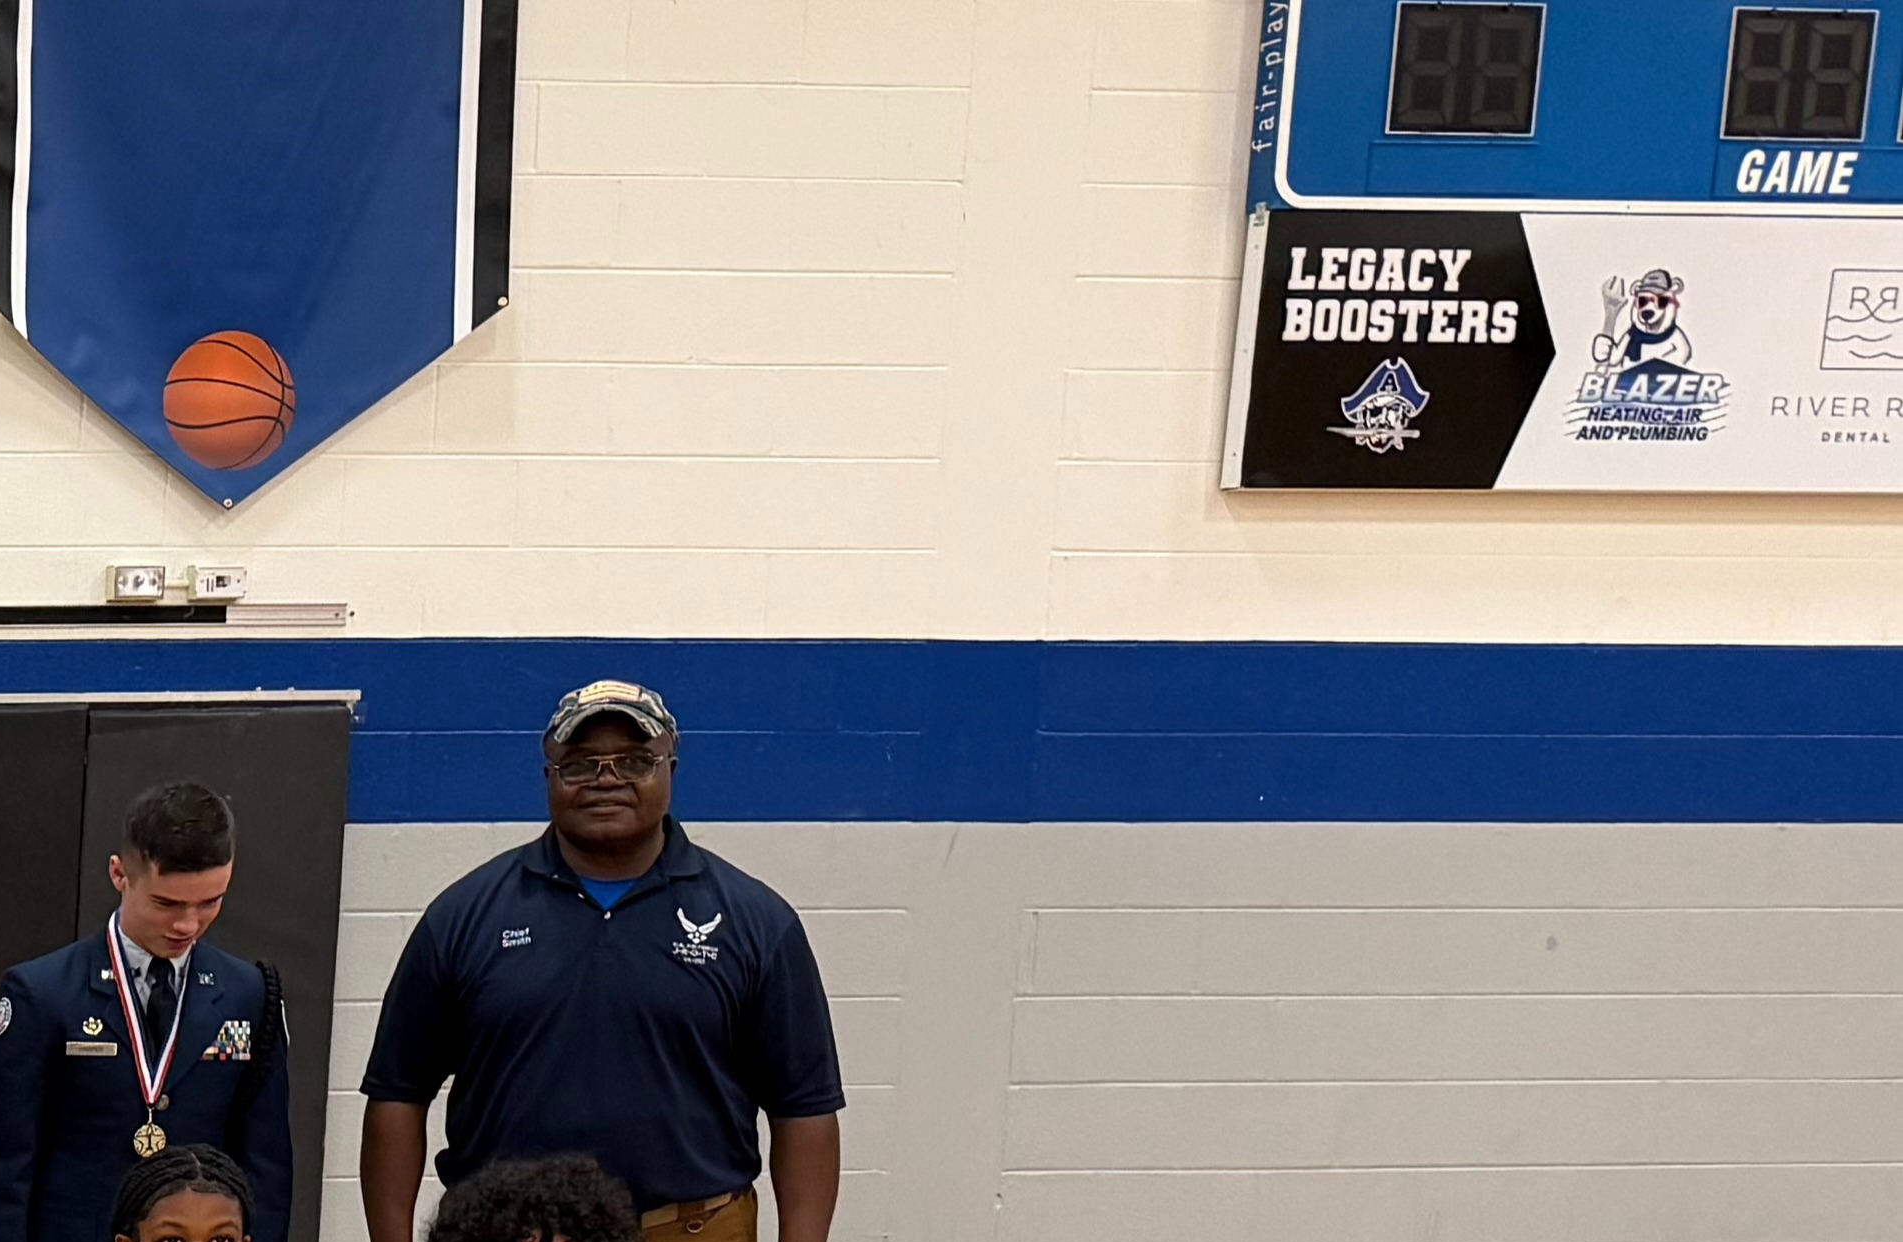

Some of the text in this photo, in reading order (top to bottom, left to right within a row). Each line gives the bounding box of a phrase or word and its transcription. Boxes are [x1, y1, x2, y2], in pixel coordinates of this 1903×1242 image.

[1252, 2, 1289, 153] fair-play
[1734, 148, 1859, 196] GAME
[1287, 246, 1471, 293] LEGACY
[1281, 298, 1519, 345] BOOSTERS
[1577, 372, 1724, 403] BLAZER
[1770, 396, 1871, 418] RIVER
[1821, 430, 1891, 444] DENTAL
[501, 926, 531, 941] Chief
[501, 935, 533, 948] Smith
